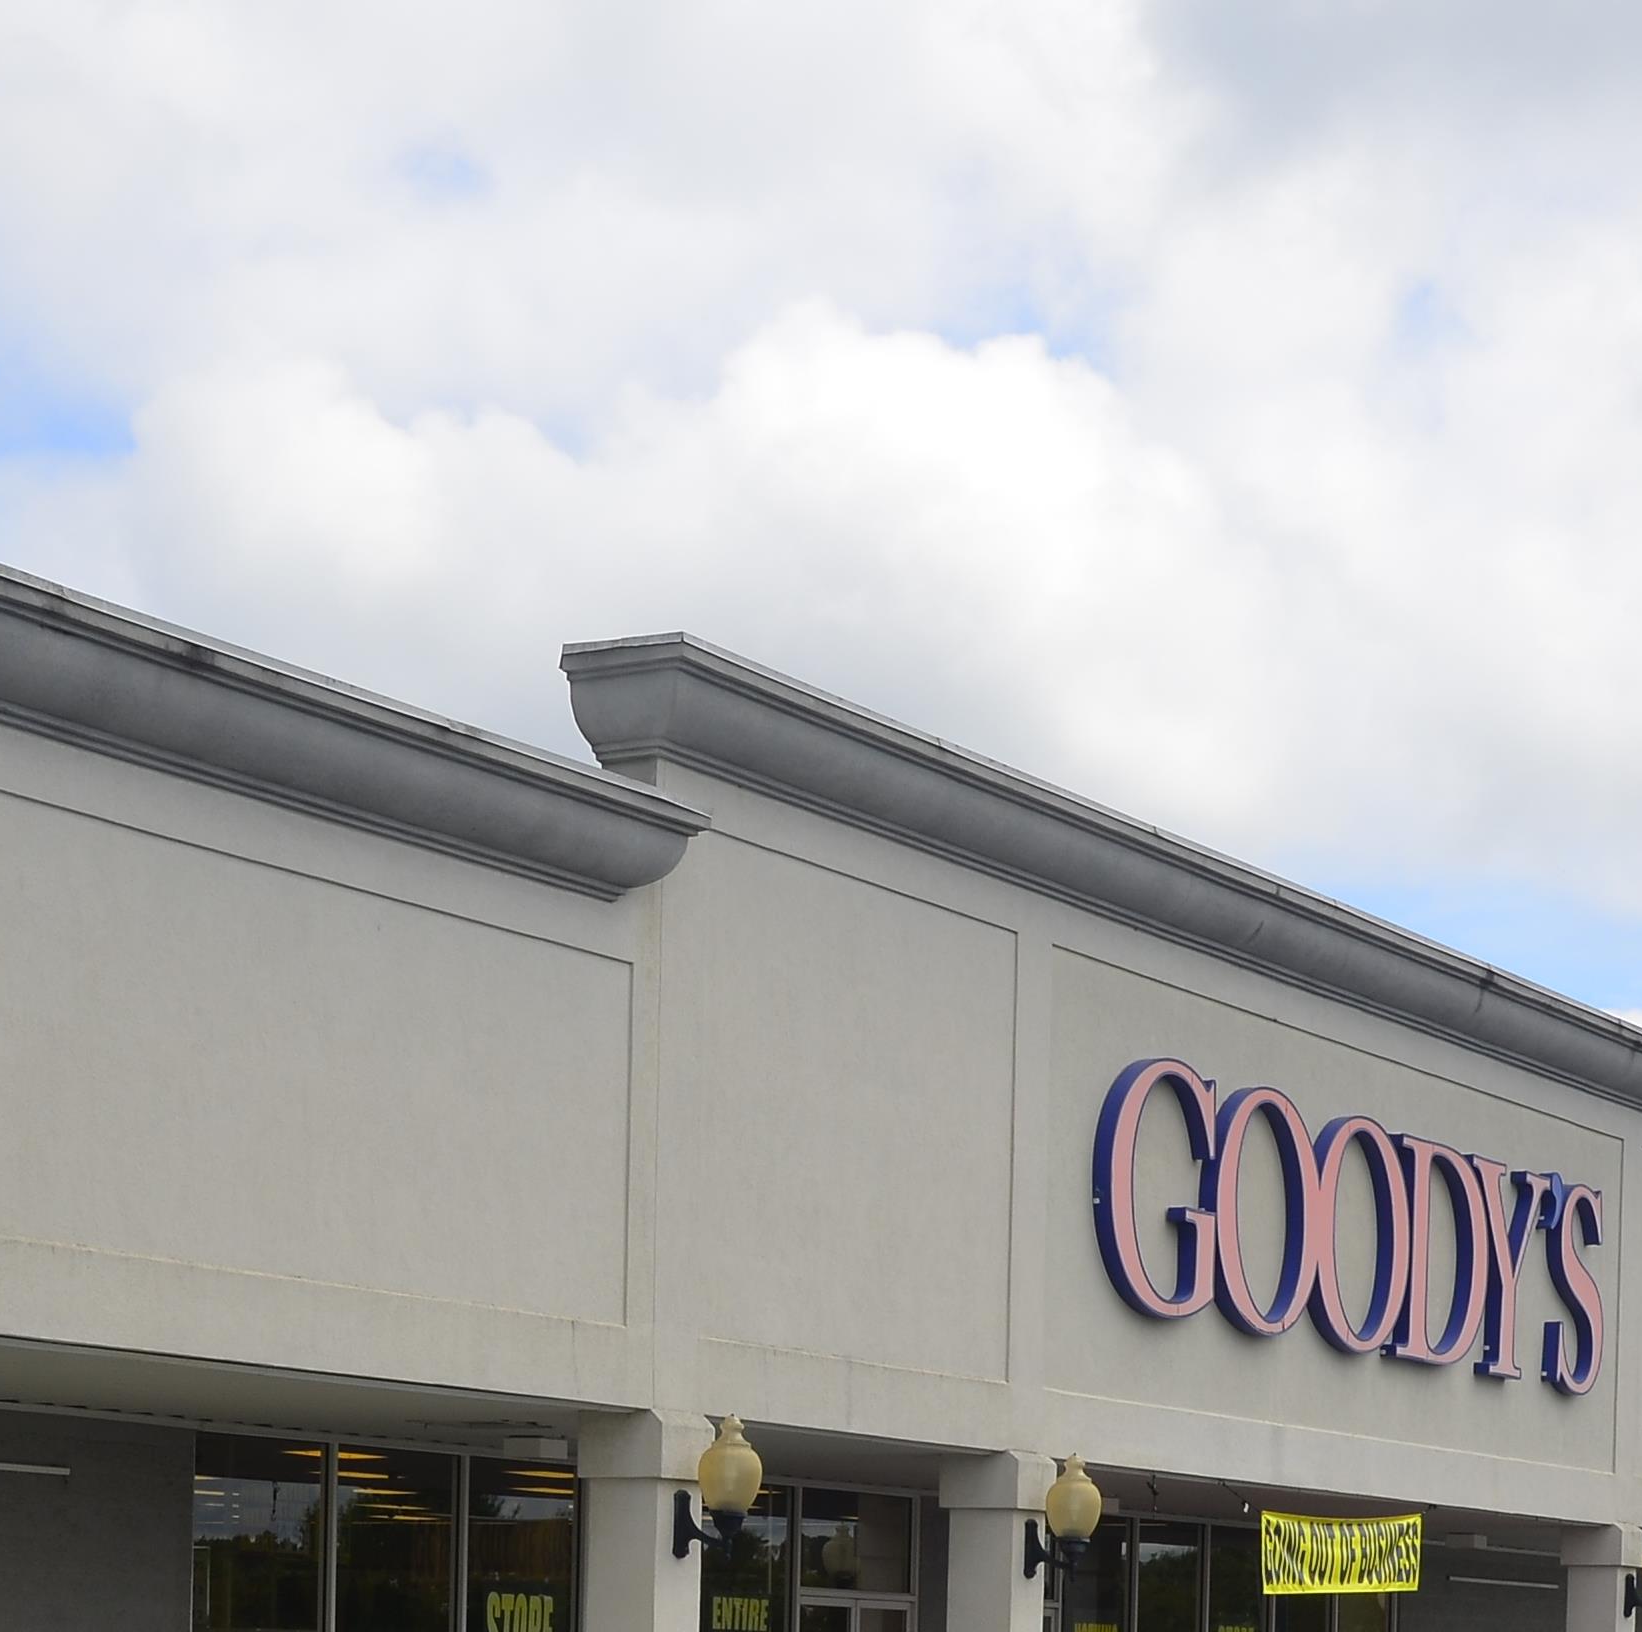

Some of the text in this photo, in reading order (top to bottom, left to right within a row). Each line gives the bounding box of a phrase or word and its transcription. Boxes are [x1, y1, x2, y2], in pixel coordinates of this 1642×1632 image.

[1092, 1058, 1604, 1396] GOODY'S
[1264, 1518, 1419, 1586] GOING OUT OF BUSINESS
[712, 1595, 770, 1632] ENTIRE
